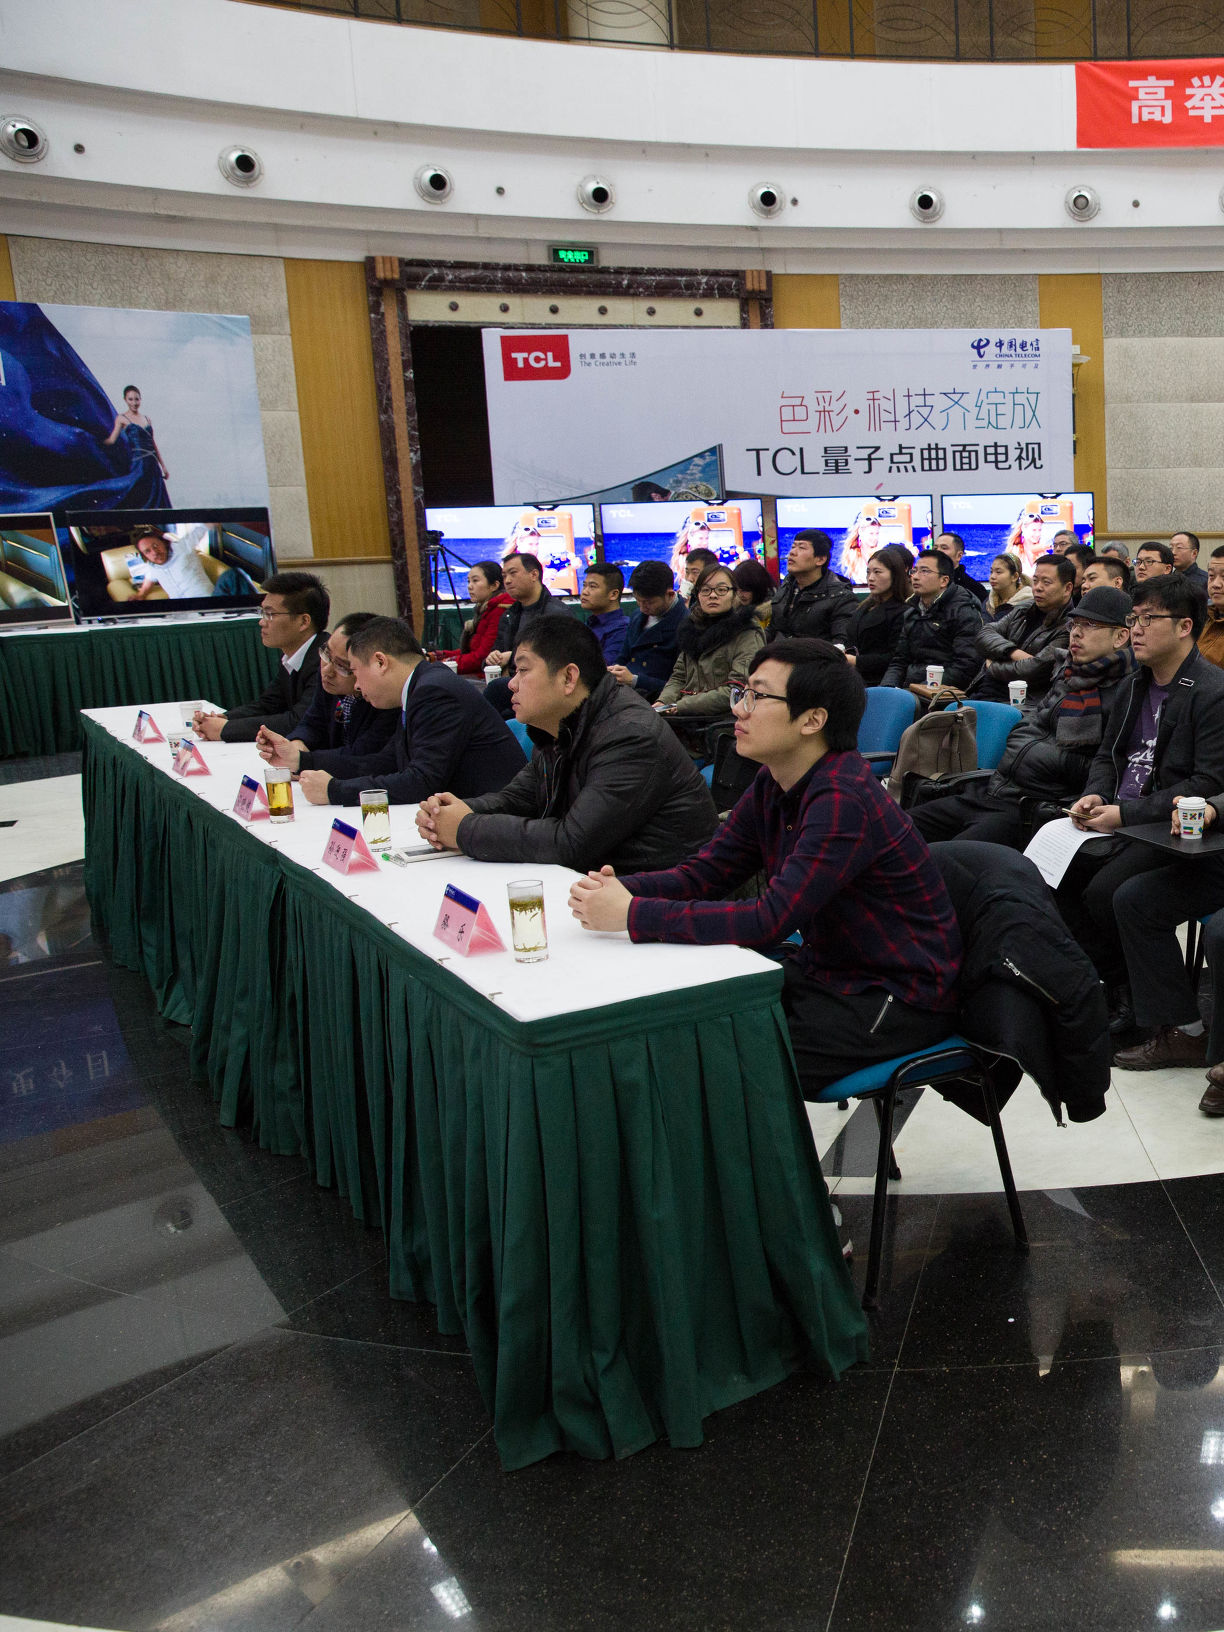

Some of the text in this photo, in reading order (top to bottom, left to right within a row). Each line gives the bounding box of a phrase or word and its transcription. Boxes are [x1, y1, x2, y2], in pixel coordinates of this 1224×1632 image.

[995, 337, 1040, 353] 中国电信
[511, 351, 562, 369] TCL
[746, 441, 1044, 476] TCL量子点曲面电视
